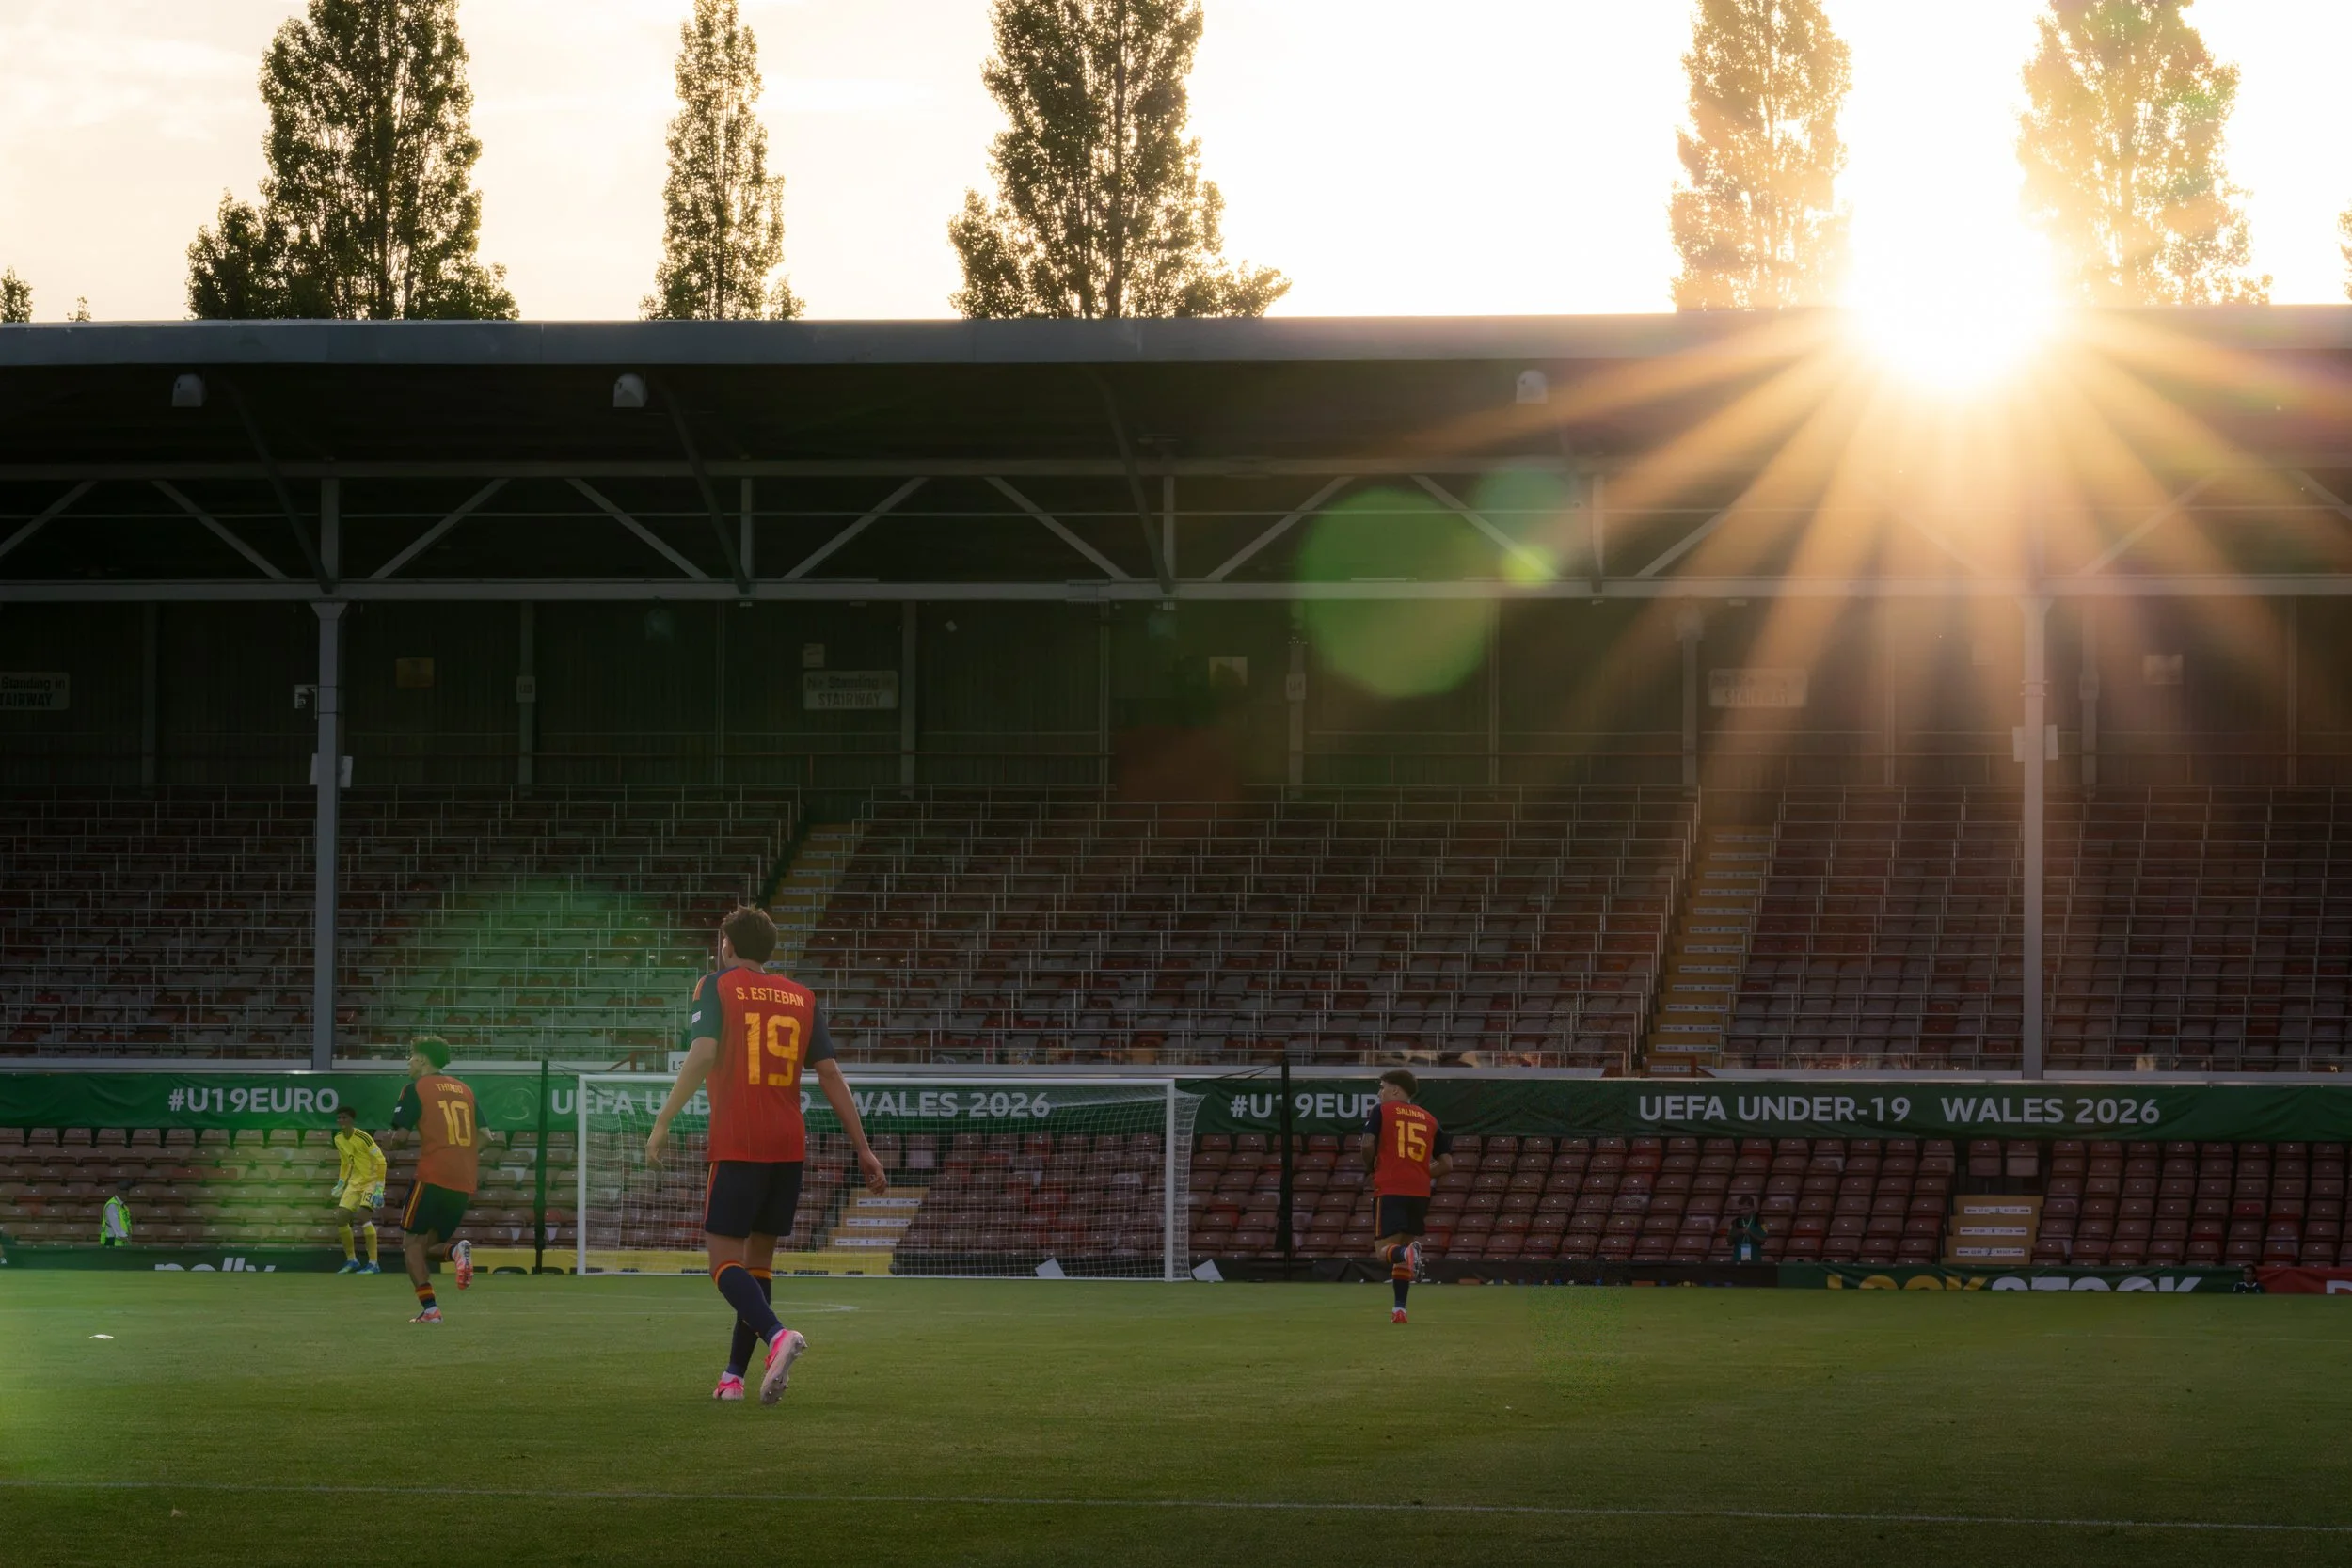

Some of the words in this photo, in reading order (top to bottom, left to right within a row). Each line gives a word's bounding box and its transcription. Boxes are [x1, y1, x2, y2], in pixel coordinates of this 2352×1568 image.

[818, 692, 882, 707] STAIRWAY
[736, 987, 749, 1000] S.
[749, 987, 804, 1008] ESTEBAN
[745, 1012, 801, 1086] 19
[167, 1087, 339, 1113] #U19EURO
[968, 1091, 1051, 1117] 2026
[1230, 1092, 1381, 1119] #U9EUR
[1639, 1095, 1728, 1121] UEFA
[1738, 1095, 1911, 1122] UNDER-19
[1940, 1097, 2065, 1123] WALES
[2074, 1098, 2161, 1124] 2026
[437, 1100, 471, 1147] 10
[1395, 1120, 1427, 1162] 15
